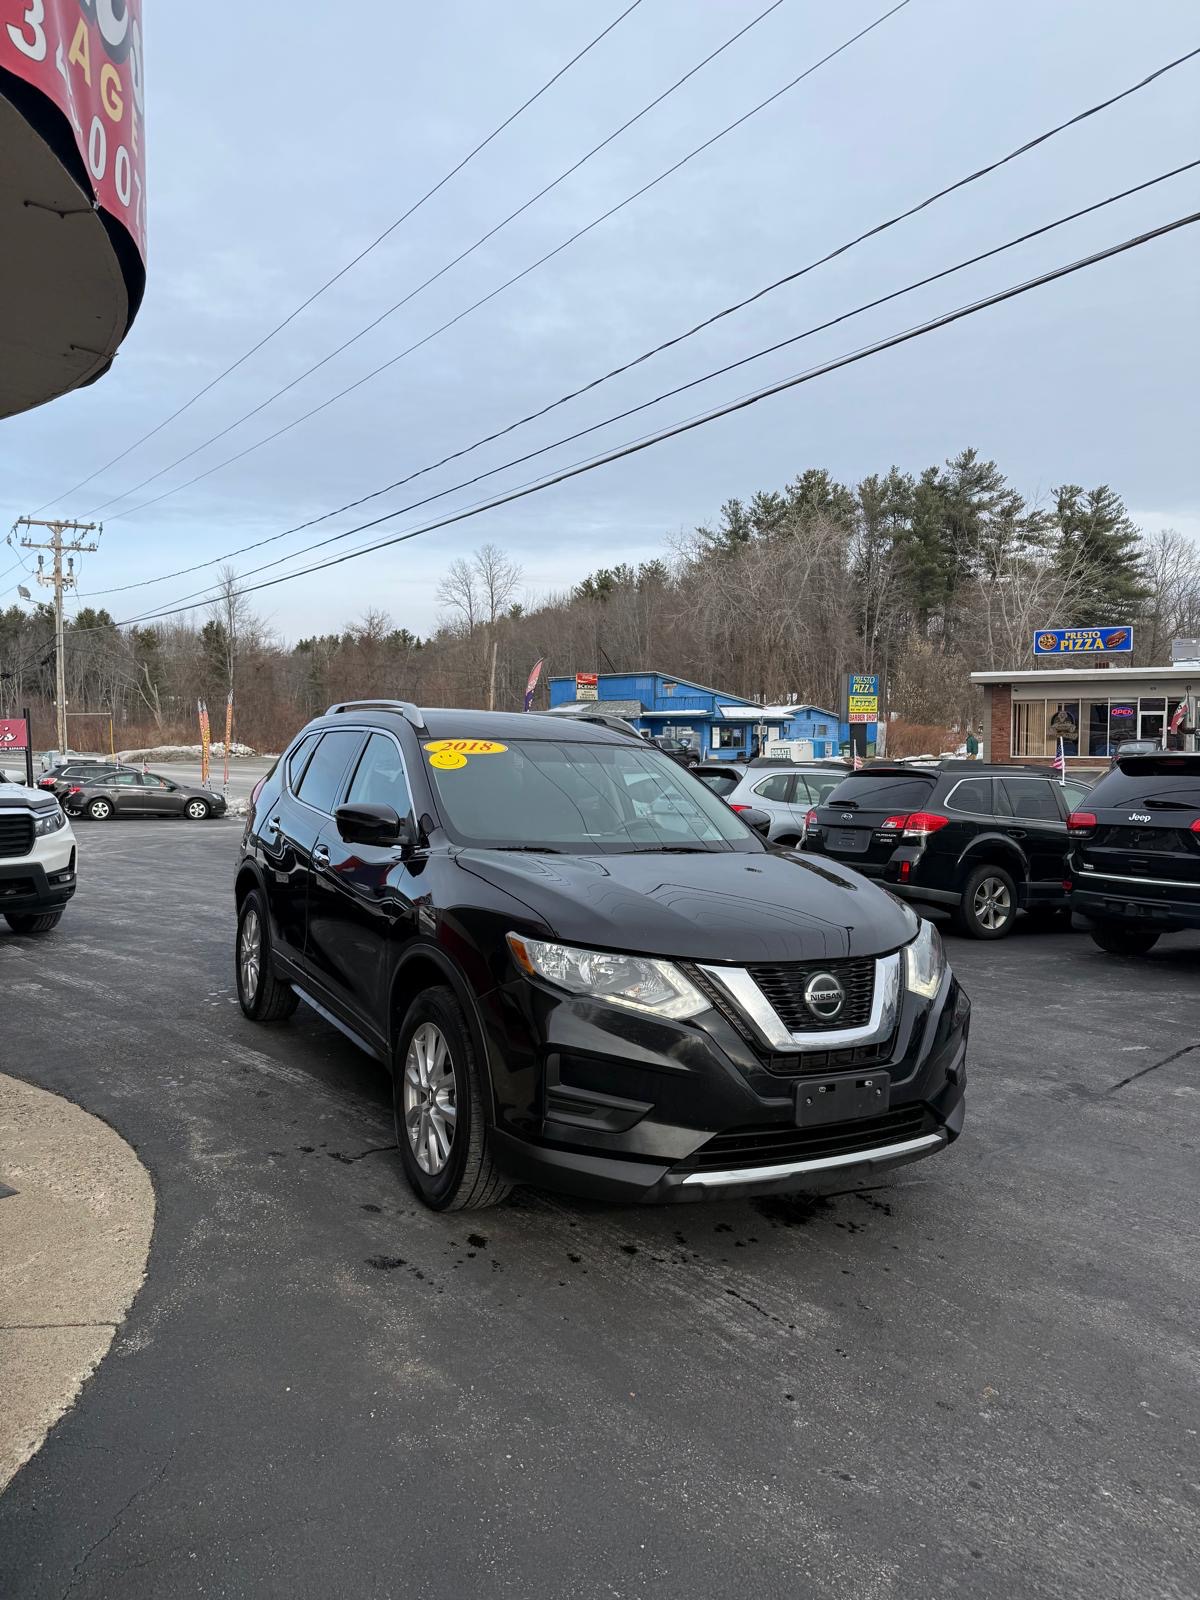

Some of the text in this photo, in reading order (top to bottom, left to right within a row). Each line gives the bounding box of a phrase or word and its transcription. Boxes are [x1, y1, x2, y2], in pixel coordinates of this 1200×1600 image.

[1065, 631, 1100, 640] PRESTO
[1060, 638, 1105, 651] PIZZA
[853, 675, 876, 684] PRESTO
[440, 742, 493, 751] 2018
[1128, 812, 1152, 823] Jeep
[810, 991, 843, 1002] NISSAN
